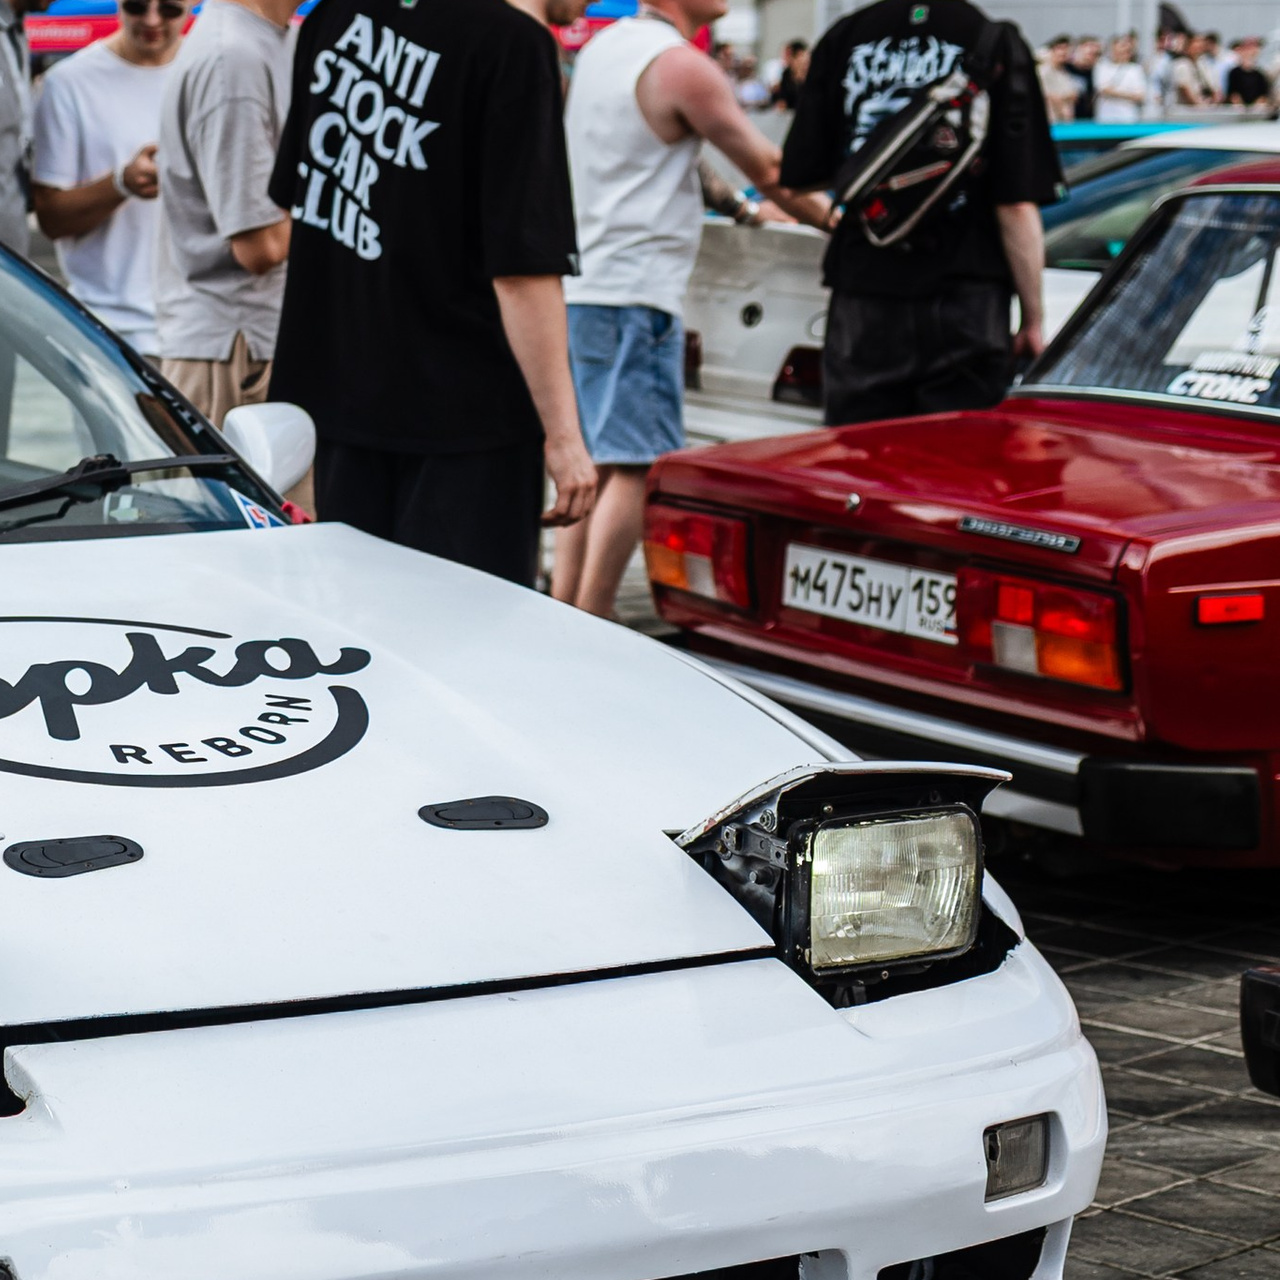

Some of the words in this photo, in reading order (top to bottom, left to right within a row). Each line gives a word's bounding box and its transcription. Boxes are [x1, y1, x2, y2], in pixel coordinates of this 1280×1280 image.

[334, 13, 441, 109] ANTI
[309, 49, 441, 170] STOCK
[308, 111, 380, 210] CAR
[911, 577, 957, 620] 159
[108, 693, 312, 765] REBORN
